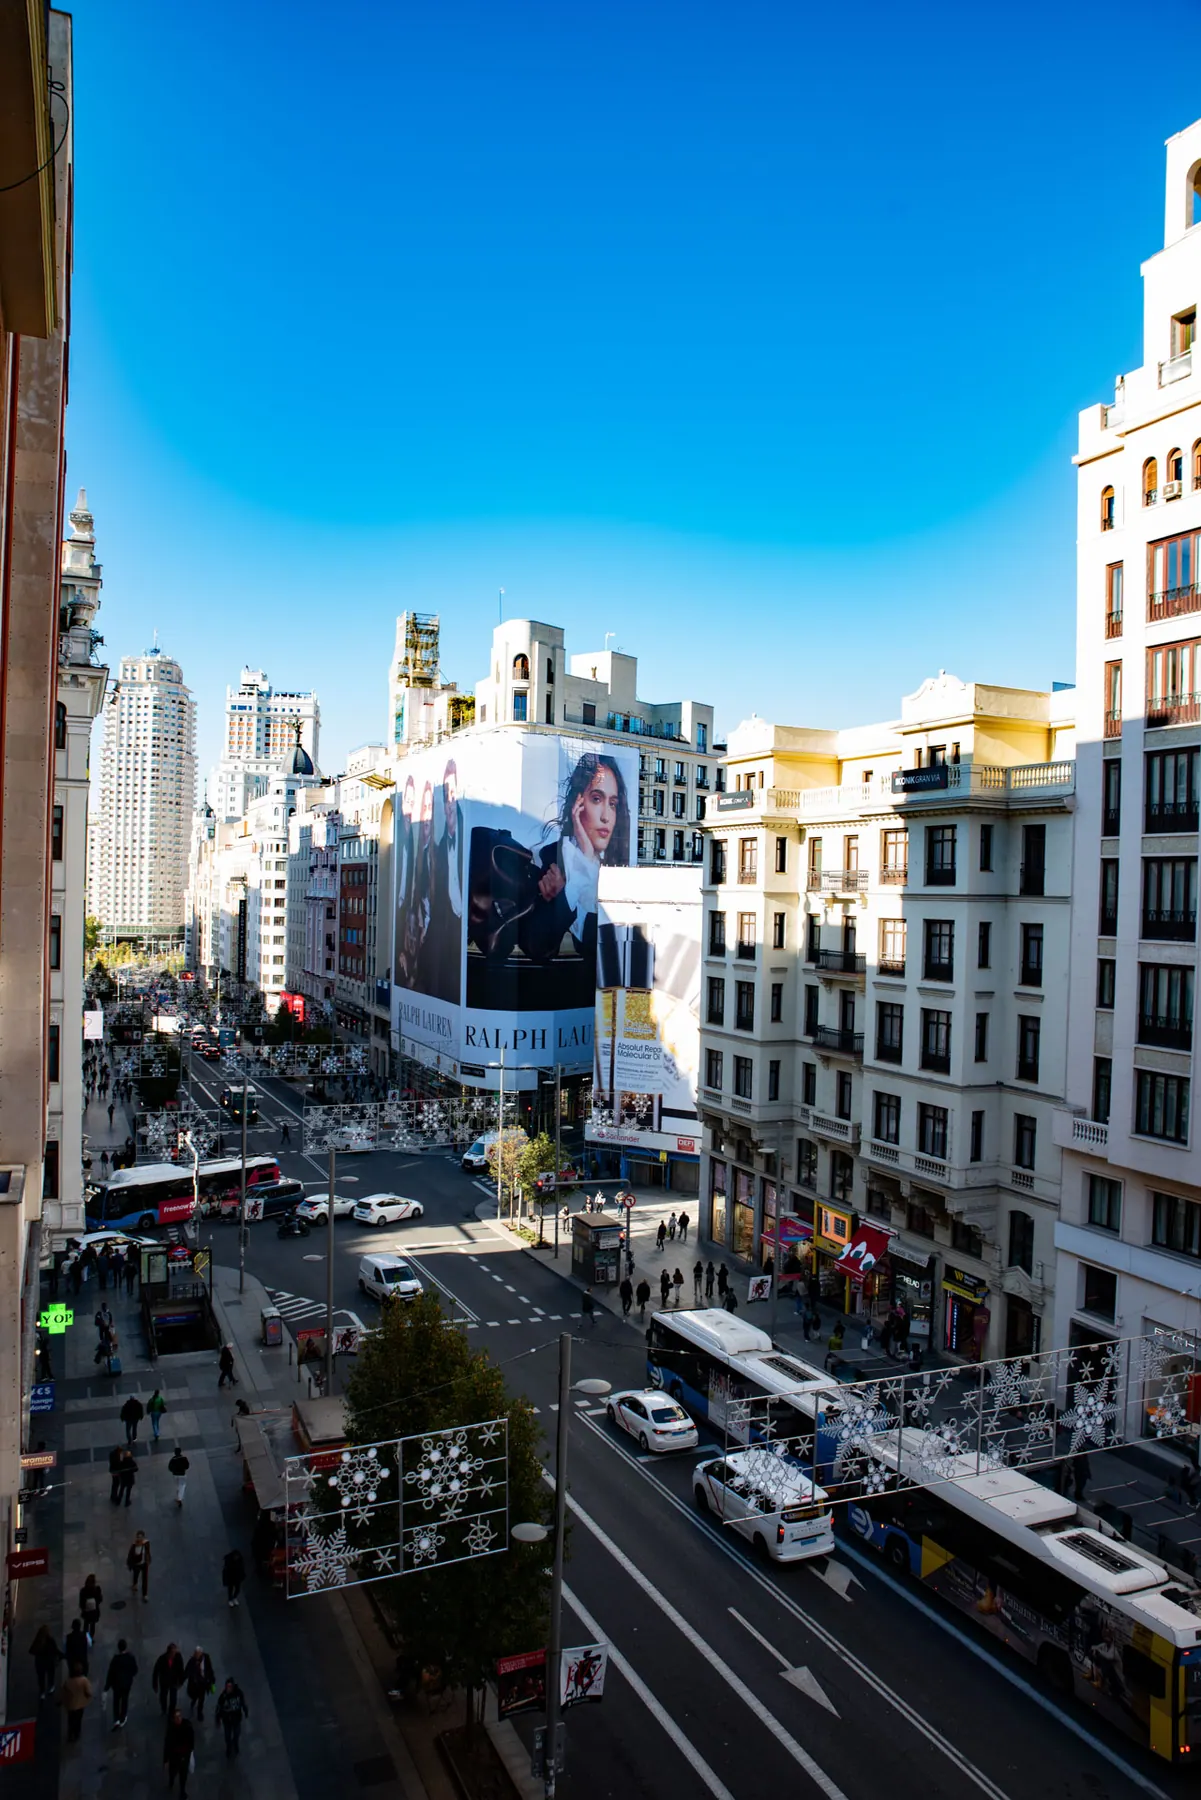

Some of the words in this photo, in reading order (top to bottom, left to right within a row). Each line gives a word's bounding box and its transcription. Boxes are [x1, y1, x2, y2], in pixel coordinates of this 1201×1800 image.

[399, 1002, 420, 1027] RALPH
[422, 1010, 452, 1039] LAUREN
[465, 1025, 547, 1050] RALPH
[617, 1042, 643, 1052] Absolut
[617, 1050, 652, 1060] Molecular
[606, 1132, 640, 1143] Santander
[43, 1315, 50, 1324] Y
[54, 1314, 72, 1324] OP
[12, 1558, 45, 1568] VIPS
